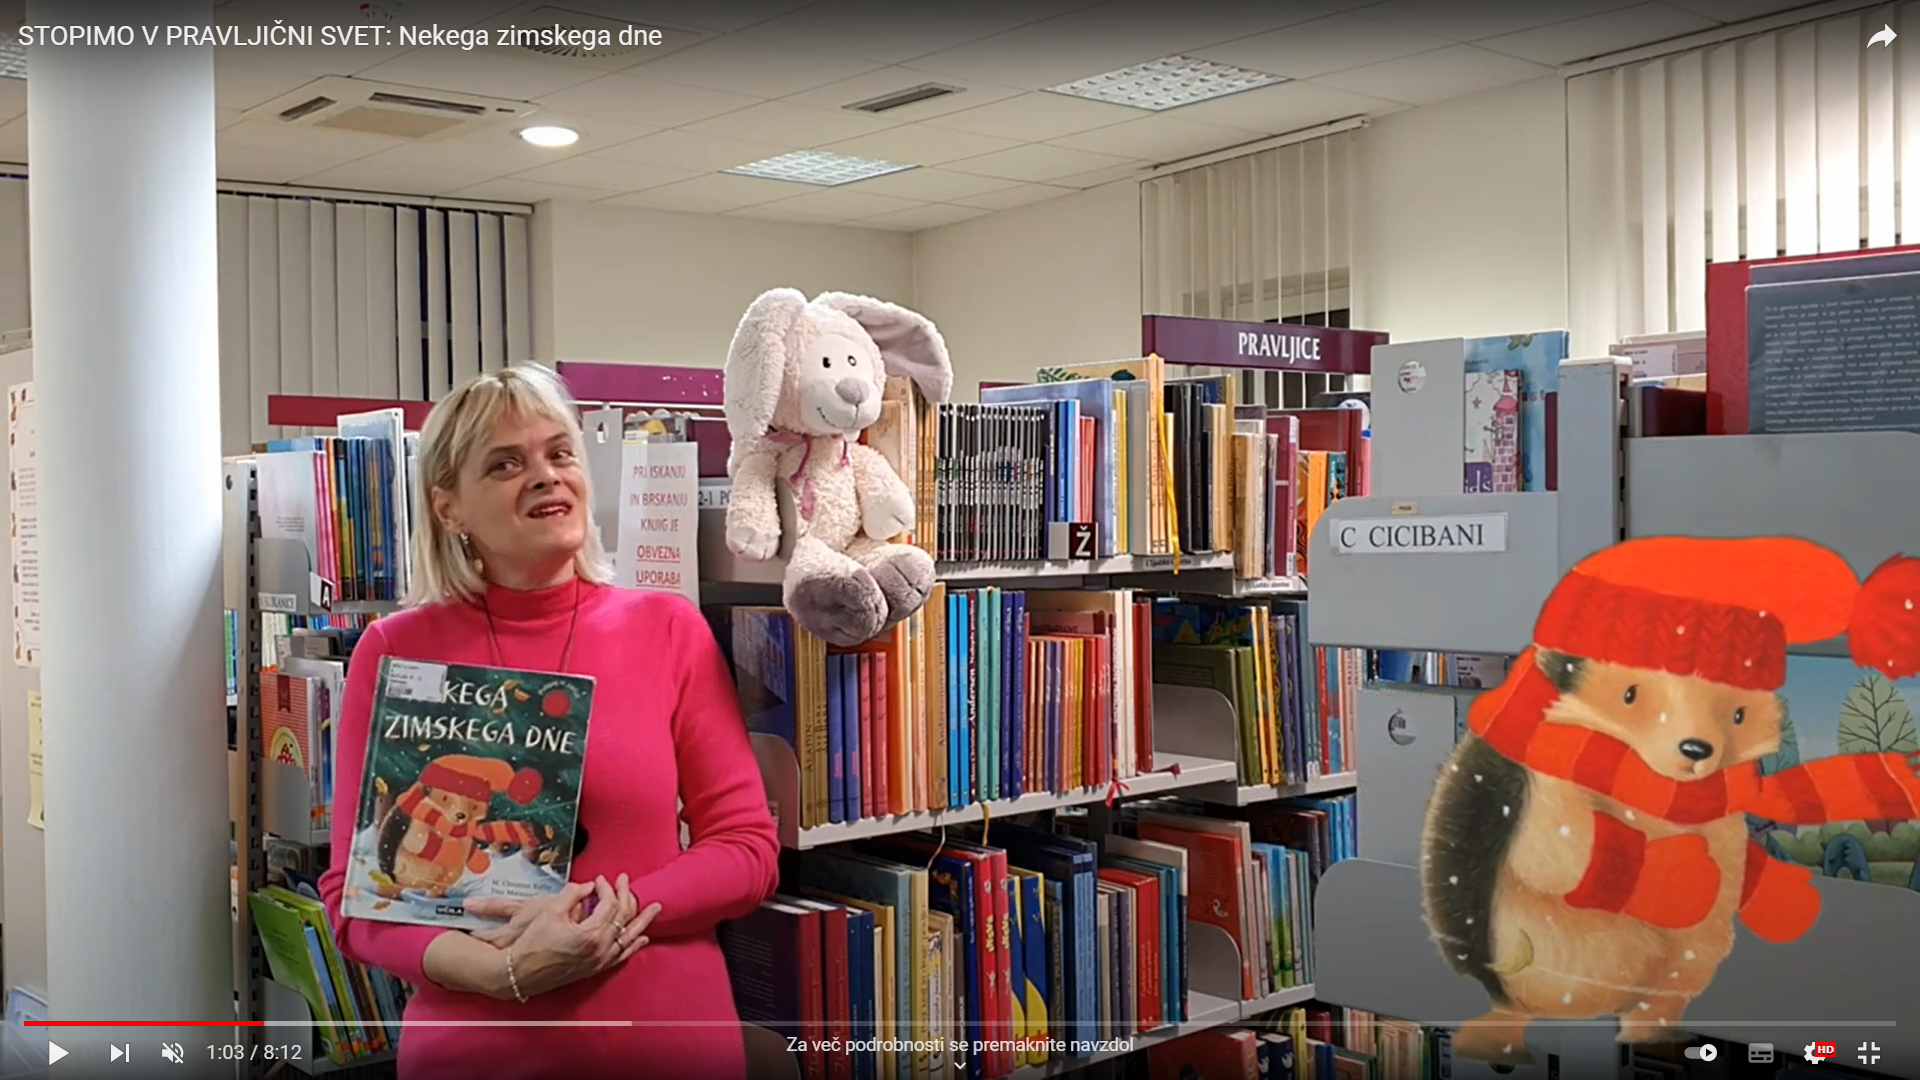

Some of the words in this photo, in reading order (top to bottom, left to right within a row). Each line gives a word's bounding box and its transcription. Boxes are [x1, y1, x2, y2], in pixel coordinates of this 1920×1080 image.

[1238, 332, 1321, 364] PRAVLJICE
[650, 466, 686, 479] ISKANJU
[630, 493, 640, 506] IN
[642, 493, 688, 506] BRSKANJU
[641, 518, 668, 531] KNJIG
[670, 519, 679, 532] JE
[1341, 526, 1356, 548] C
[1369, 524, 1483, 548] CICIBANI
[1076, 525, 1091, 556] Ž
[637, 545, 681, 560] OBVEZNA
[636, 571, 681, 586] UPORABA
[322, 585, 331, 608] A
[441, 681, 508, 709] KEGA
[967, 669, 976, 726] Andersen
[384, 714, 515, 746] ZIMSKEGA
[525, 725, 577, 754] DNE
